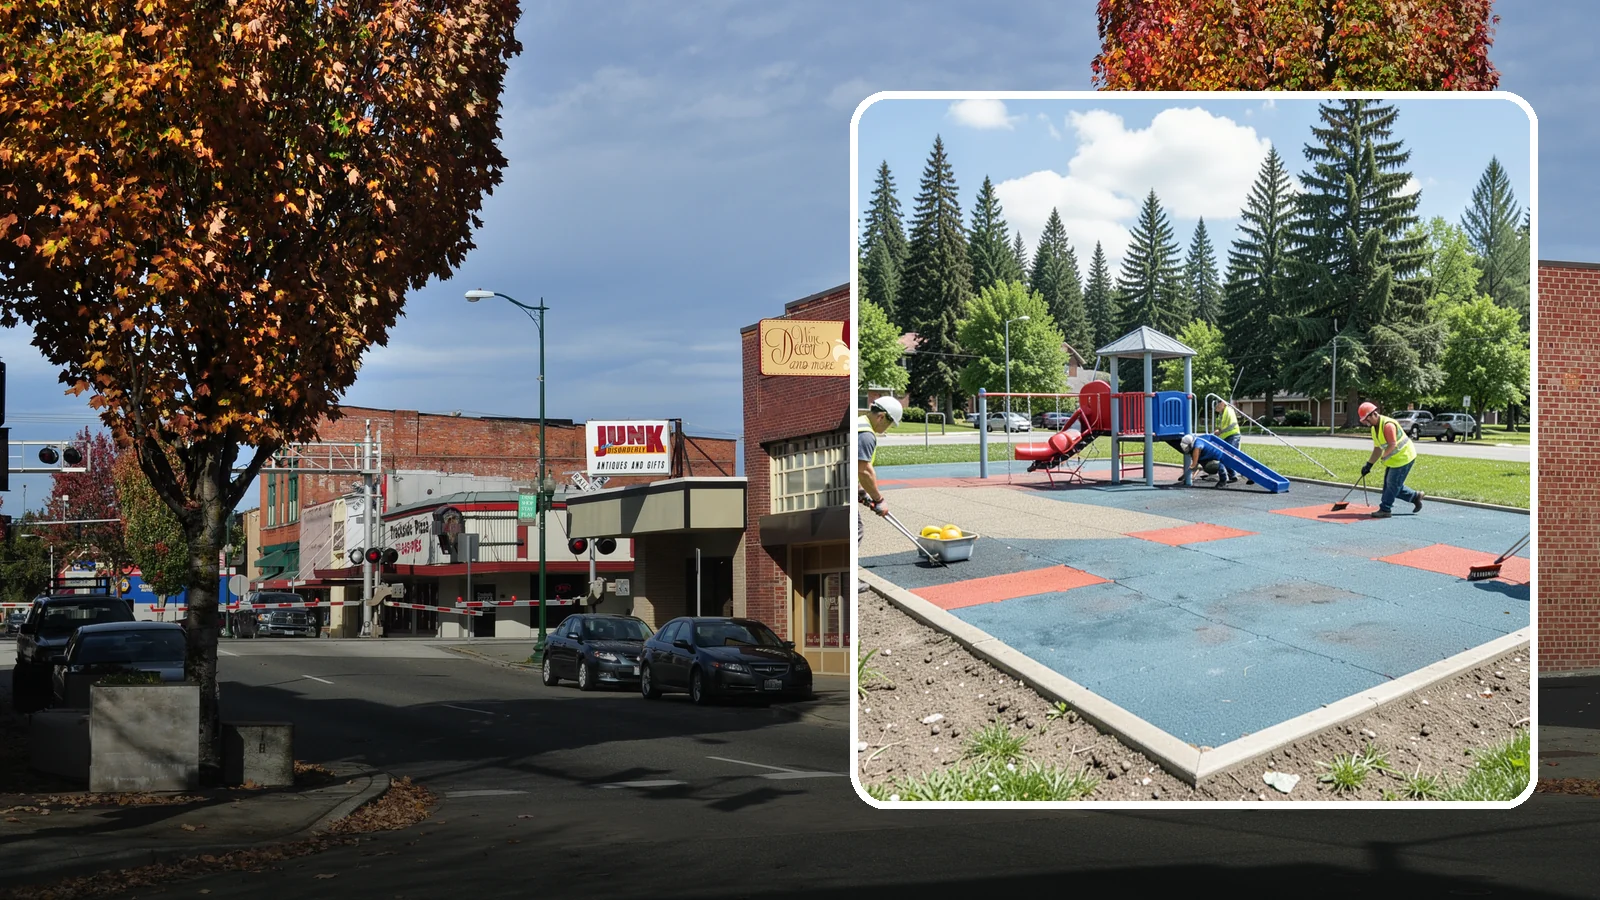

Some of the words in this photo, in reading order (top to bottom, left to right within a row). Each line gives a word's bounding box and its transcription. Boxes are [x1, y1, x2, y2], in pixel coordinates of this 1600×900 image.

[811, 361, 835, 370] MORE
[595, 425, 664, 457] JUNK
[607, 446, 646, 454] DISORDERLY
[597, 461, 628, 470] ANTIQUES
[631, 461, 644, 469] AND
[646, 460, 665, 469] GIFTS
[414, 519, 429, 534] Pizza
